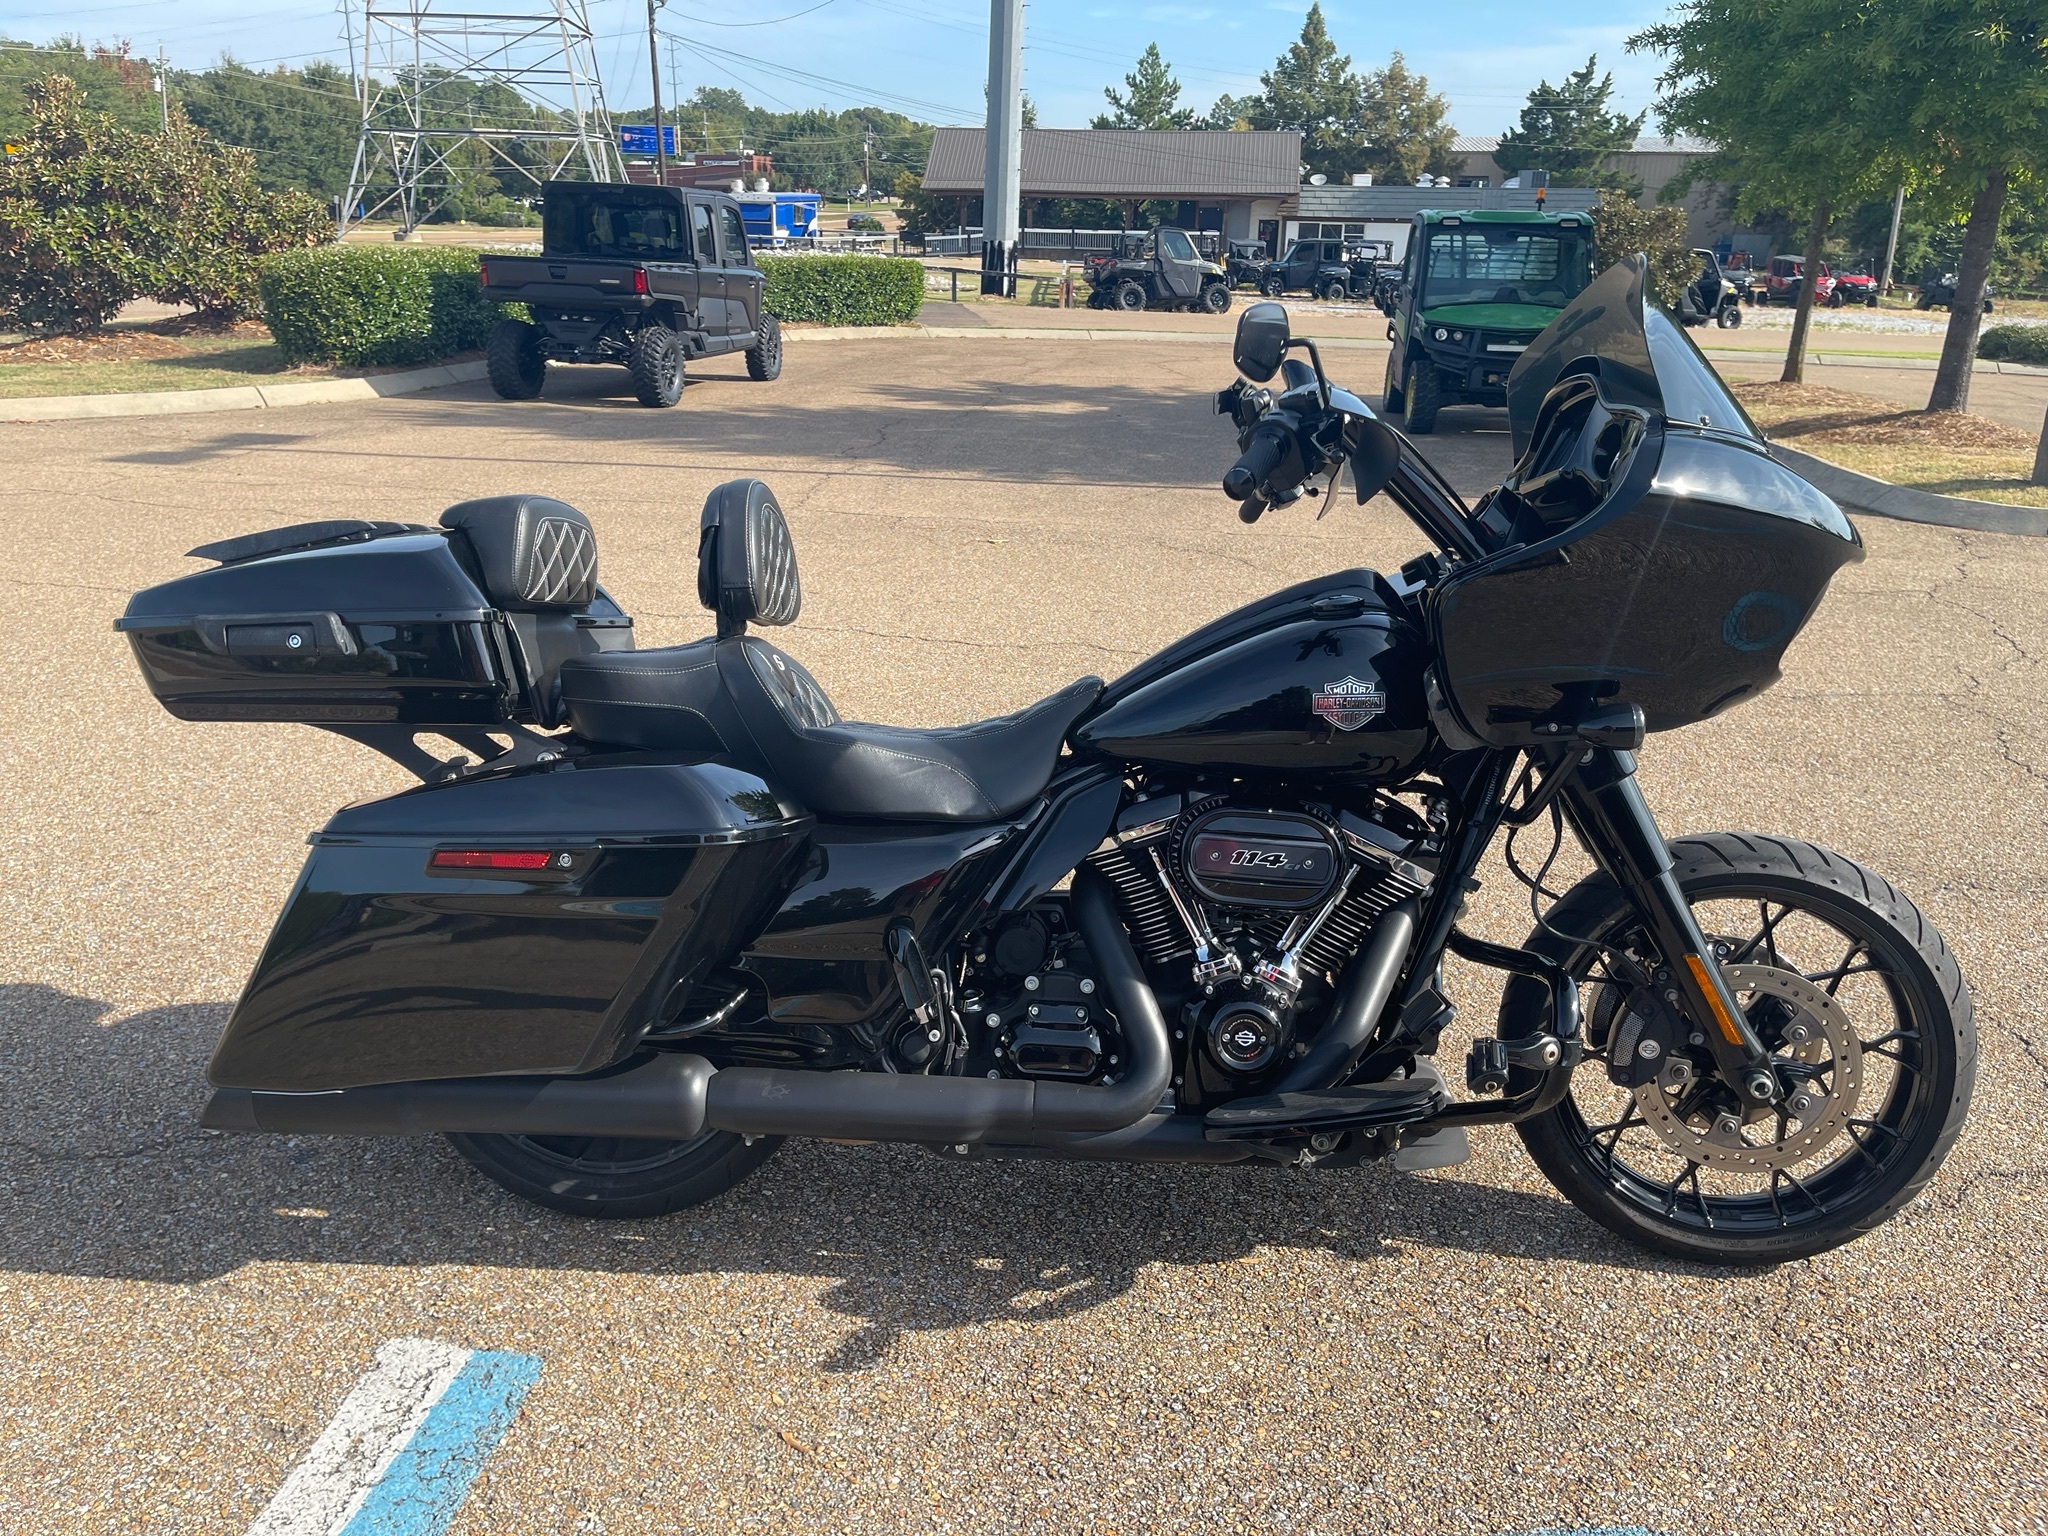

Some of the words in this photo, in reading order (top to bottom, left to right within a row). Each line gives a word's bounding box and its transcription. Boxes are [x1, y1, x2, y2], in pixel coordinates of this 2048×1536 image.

[1333, 682, 1366, 694] MOTOR
[1318, 697, 1380, 708] HARLEY-DAVIDSON
[1230, 849, 1289, 868] 114
